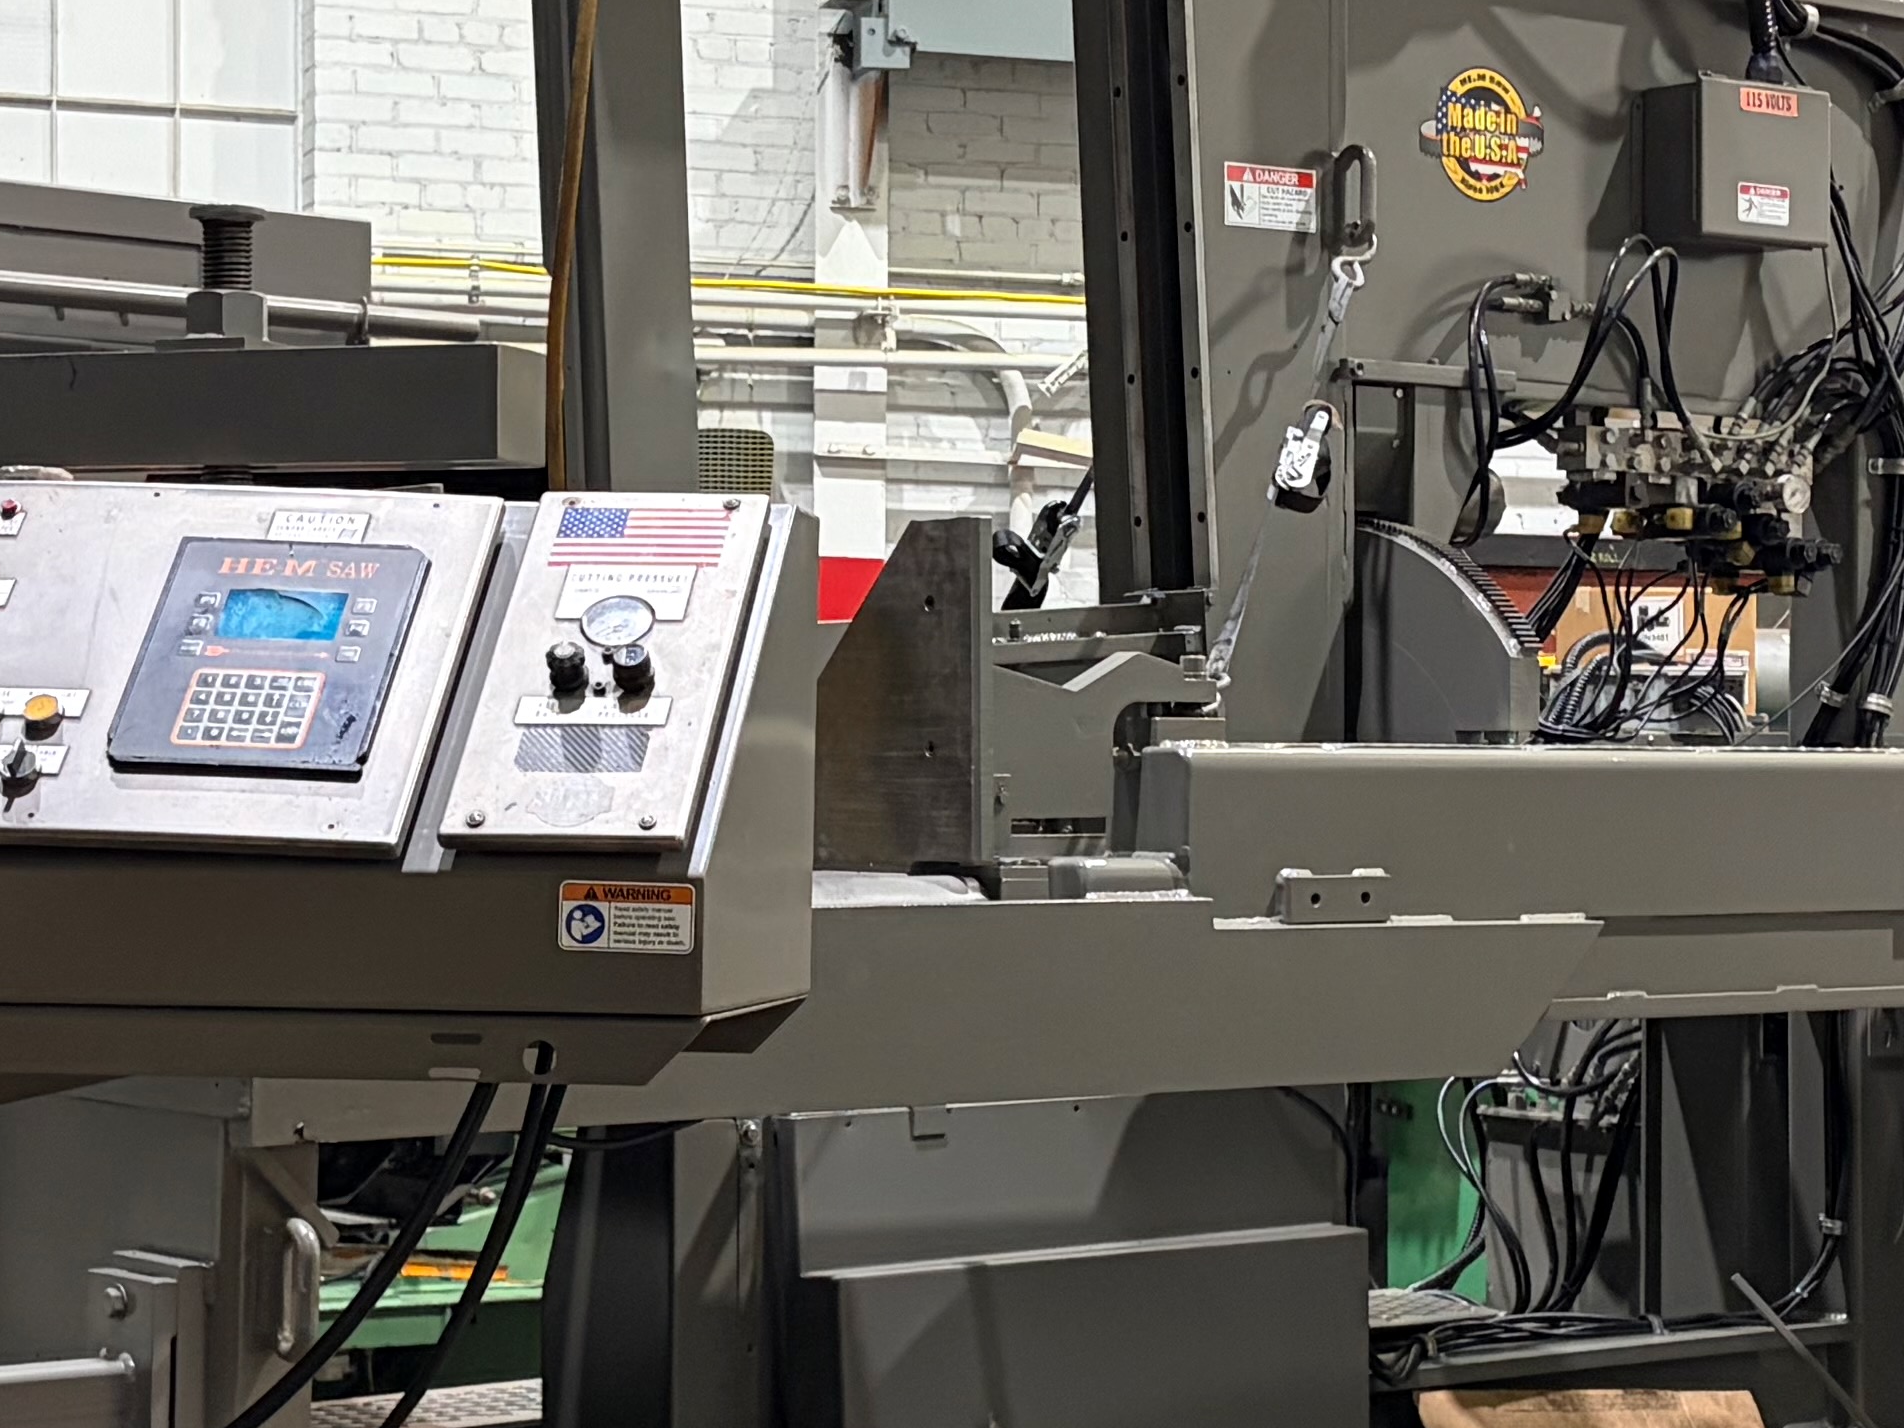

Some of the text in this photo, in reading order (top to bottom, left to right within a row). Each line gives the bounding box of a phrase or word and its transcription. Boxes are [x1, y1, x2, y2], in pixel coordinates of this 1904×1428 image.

[1746, 91, 1792, 112] 115 VOLTS
[1447, 101, 1497, 132] Made
[1442, 131, 1472, 158] the
[1256, 170, 1299, 185] DANGER
[1266, 186, 1280, 195] CUT
[286, 513, 356, 525] CAUTION
[325, 560, 380, 579] SAW
[602, 887, 672, 902] WARNING
